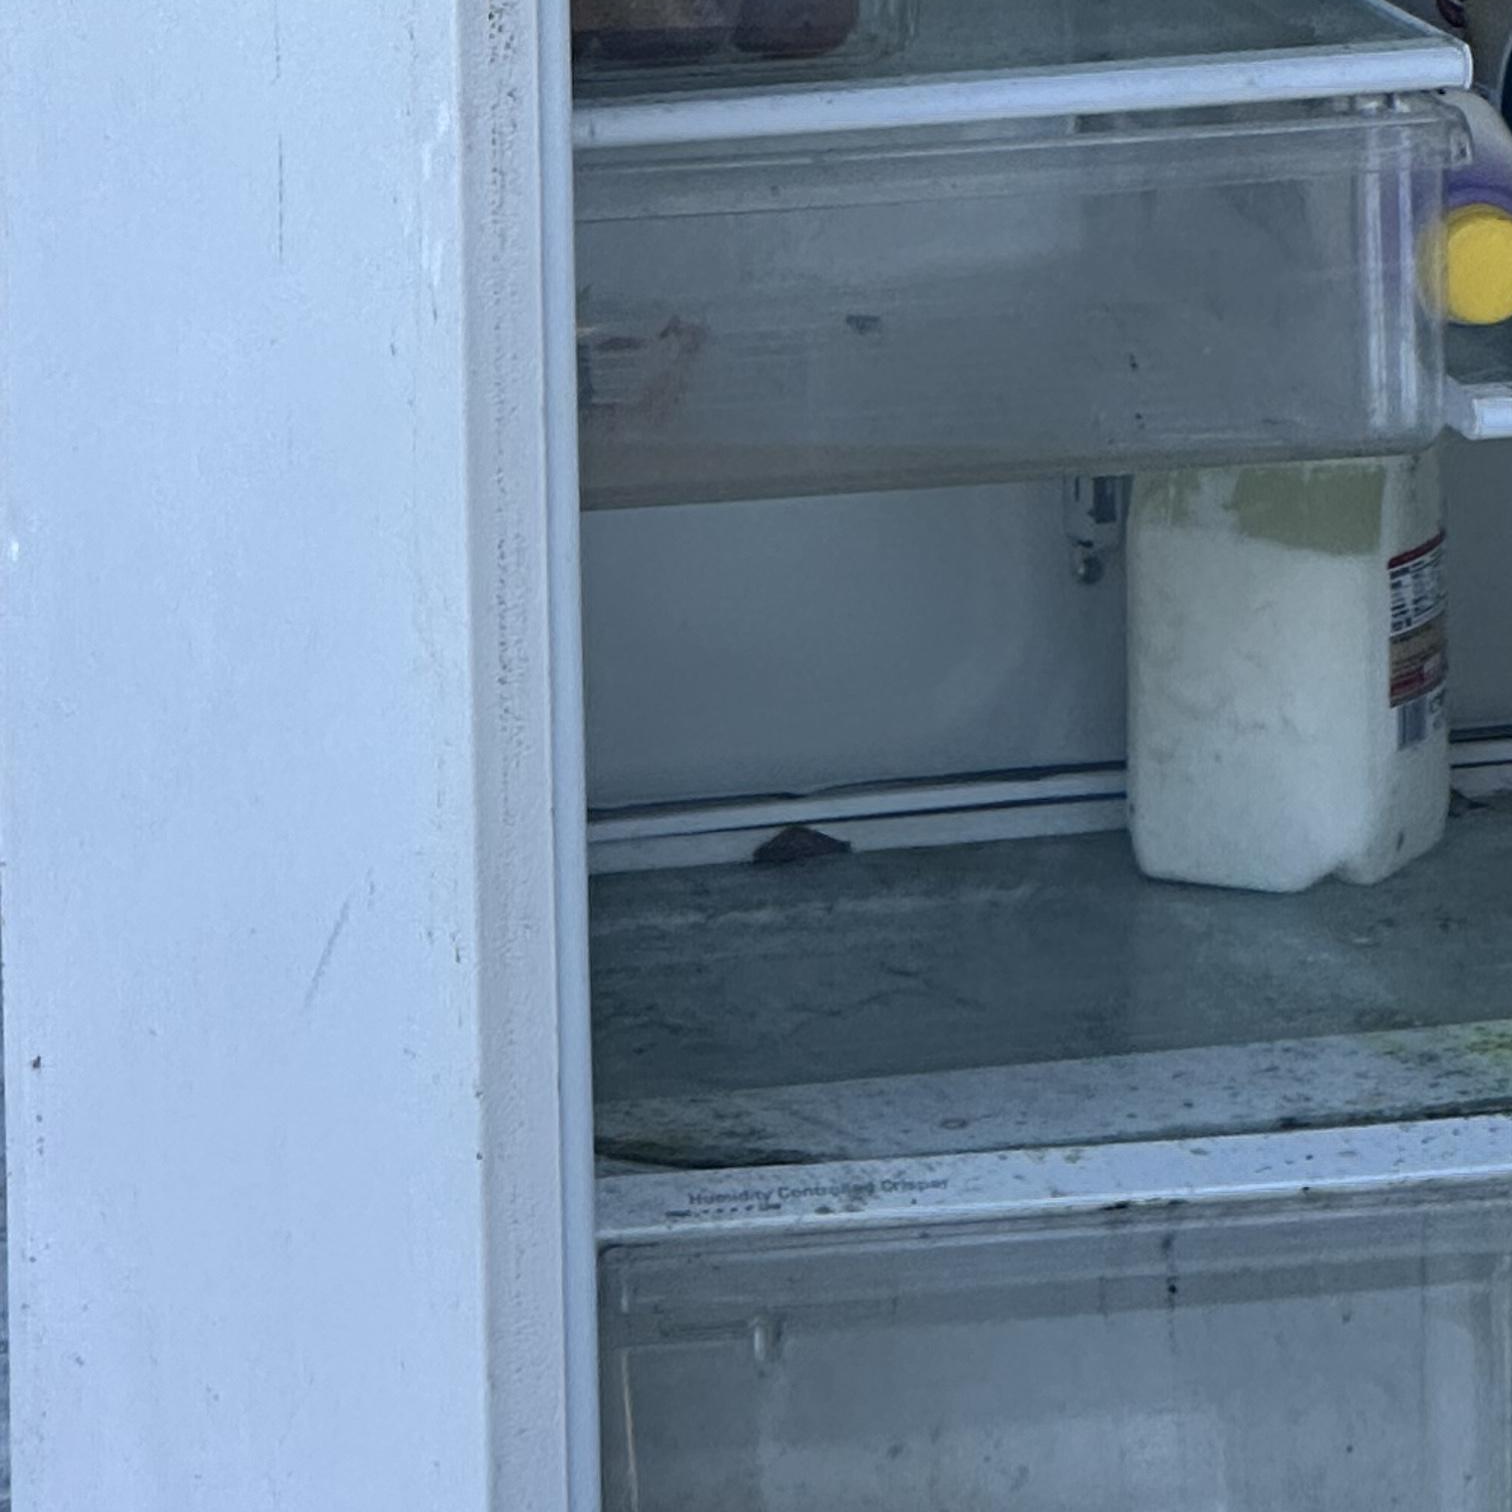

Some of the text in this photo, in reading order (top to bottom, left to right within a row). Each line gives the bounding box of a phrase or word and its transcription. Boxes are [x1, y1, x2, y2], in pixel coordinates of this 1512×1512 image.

[687, 1177, 949, 1206] Humidity Controlled Crisper
